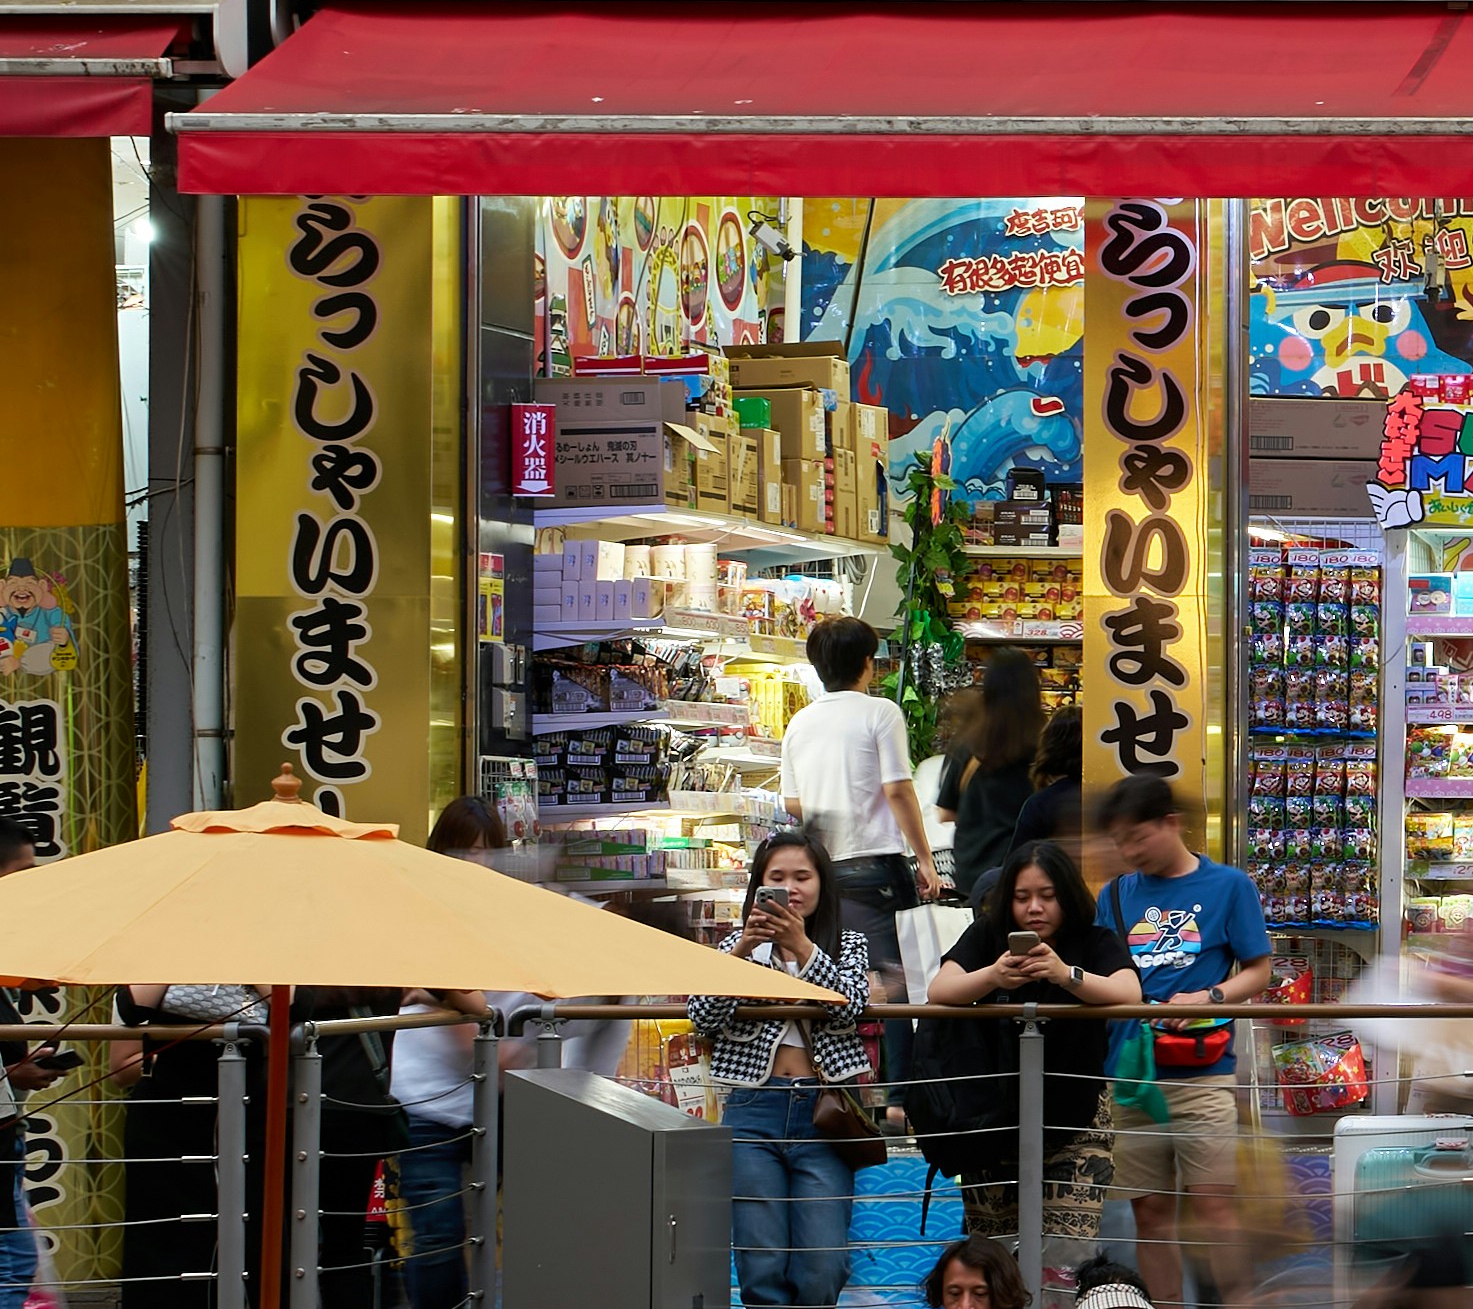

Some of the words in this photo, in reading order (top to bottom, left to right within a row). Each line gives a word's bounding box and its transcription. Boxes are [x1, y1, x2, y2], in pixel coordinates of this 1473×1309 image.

[286, 196, 381, 819] らっしゃいませ
[523, 411, 548, 480] 消火器
[1101, 197, 1193, 778] らっしゃいませ
